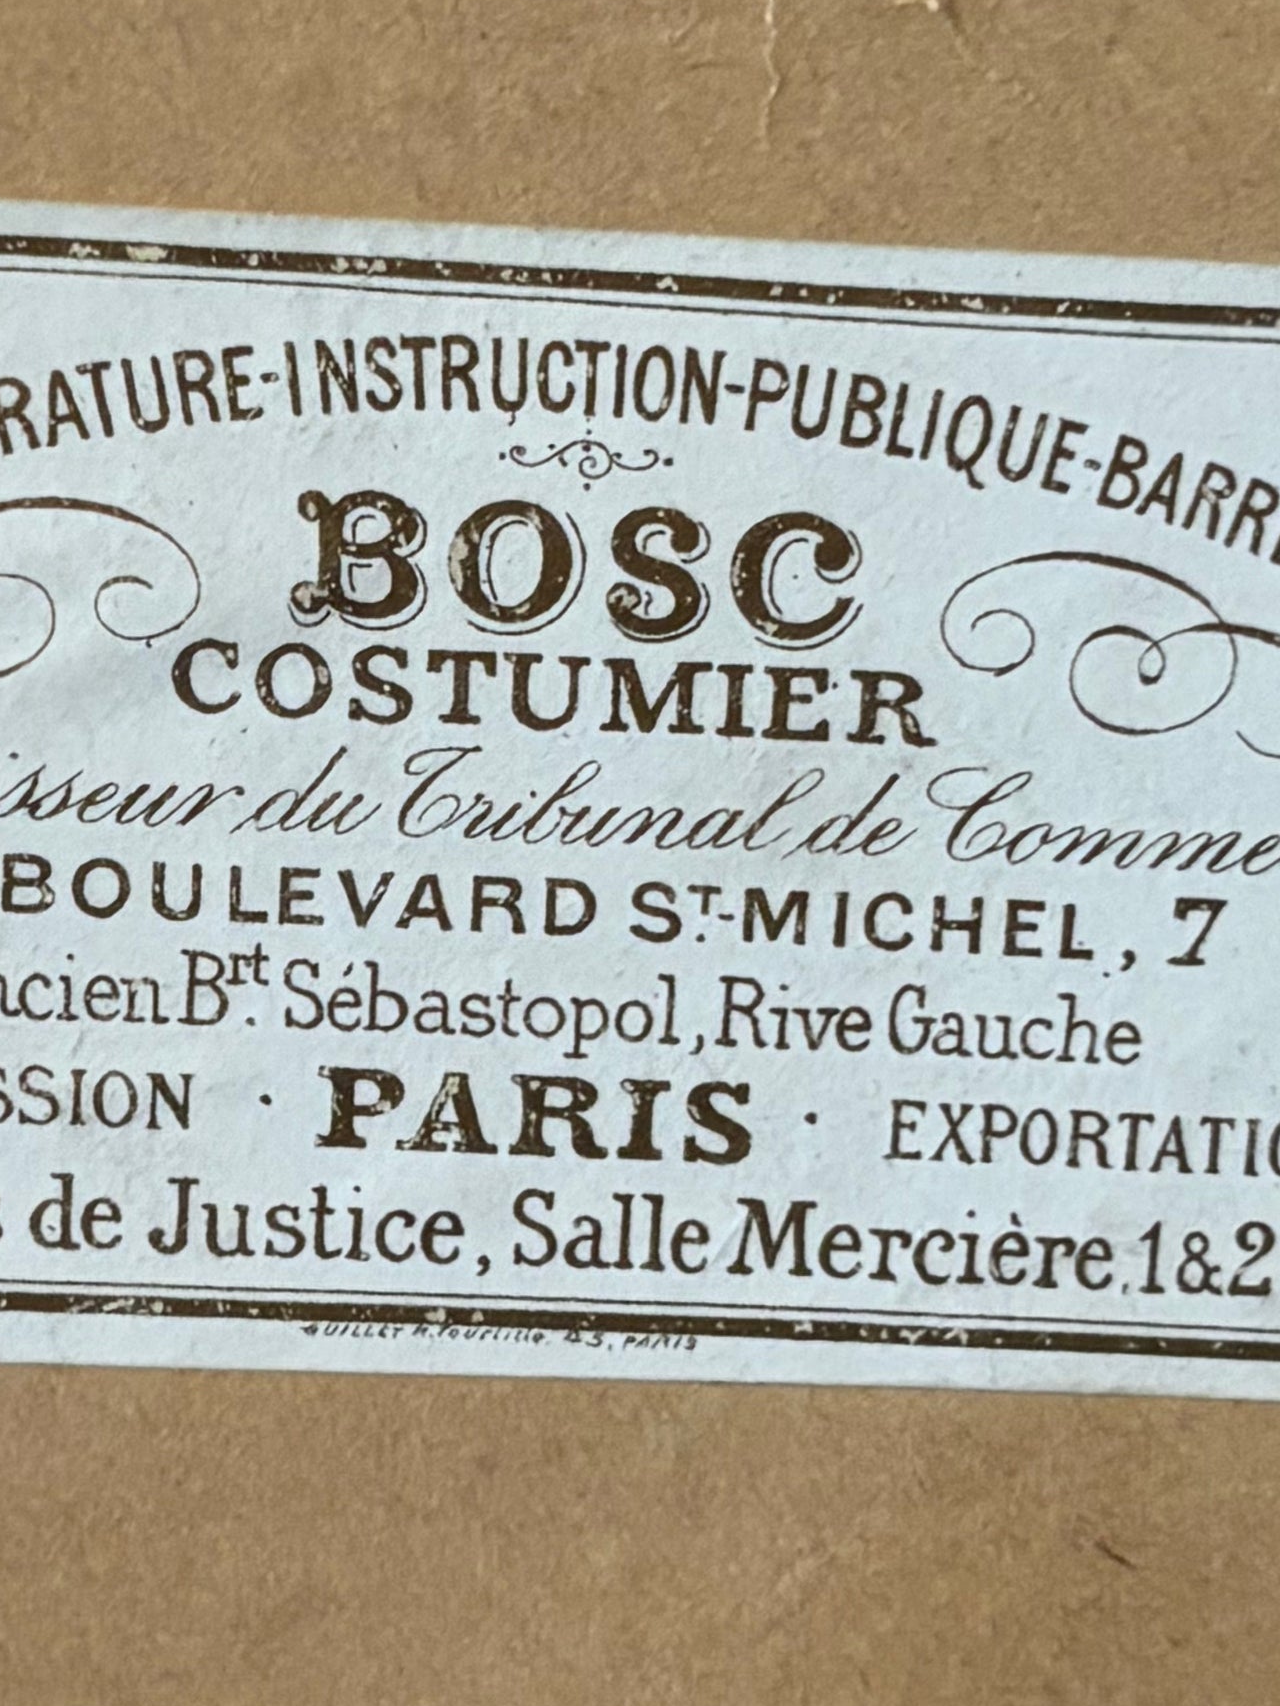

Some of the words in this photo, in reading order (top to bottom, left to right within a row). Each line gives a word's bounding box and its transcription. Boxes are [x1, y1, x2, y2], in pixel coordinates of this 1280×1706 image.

[286, 489, 864, 653] BOSC
[171, 638, 937, 749] COSTUMIER
[228, 745, 383, 836] du
[396, 745, 824, 853] Tribunal
[781, 773, 919, 859] de
[1, 852, 596, 937] BOULEVARD
[1167, 897, 1228, 967] 7
[283, 957, 705, 1061] Sébastopol,
[714, 975, 873, 1053] Rive
[888, 983, 1142, 1066] Gauche
[315, 1065, 753, 1166] PARIS
[28, 1172, 123, 1251] de
[147, 1176, 491, 1277] Justice,
[512, 1188, 711, 1275] Salle
[1138, 1220, 1276, 1298] 1&2
